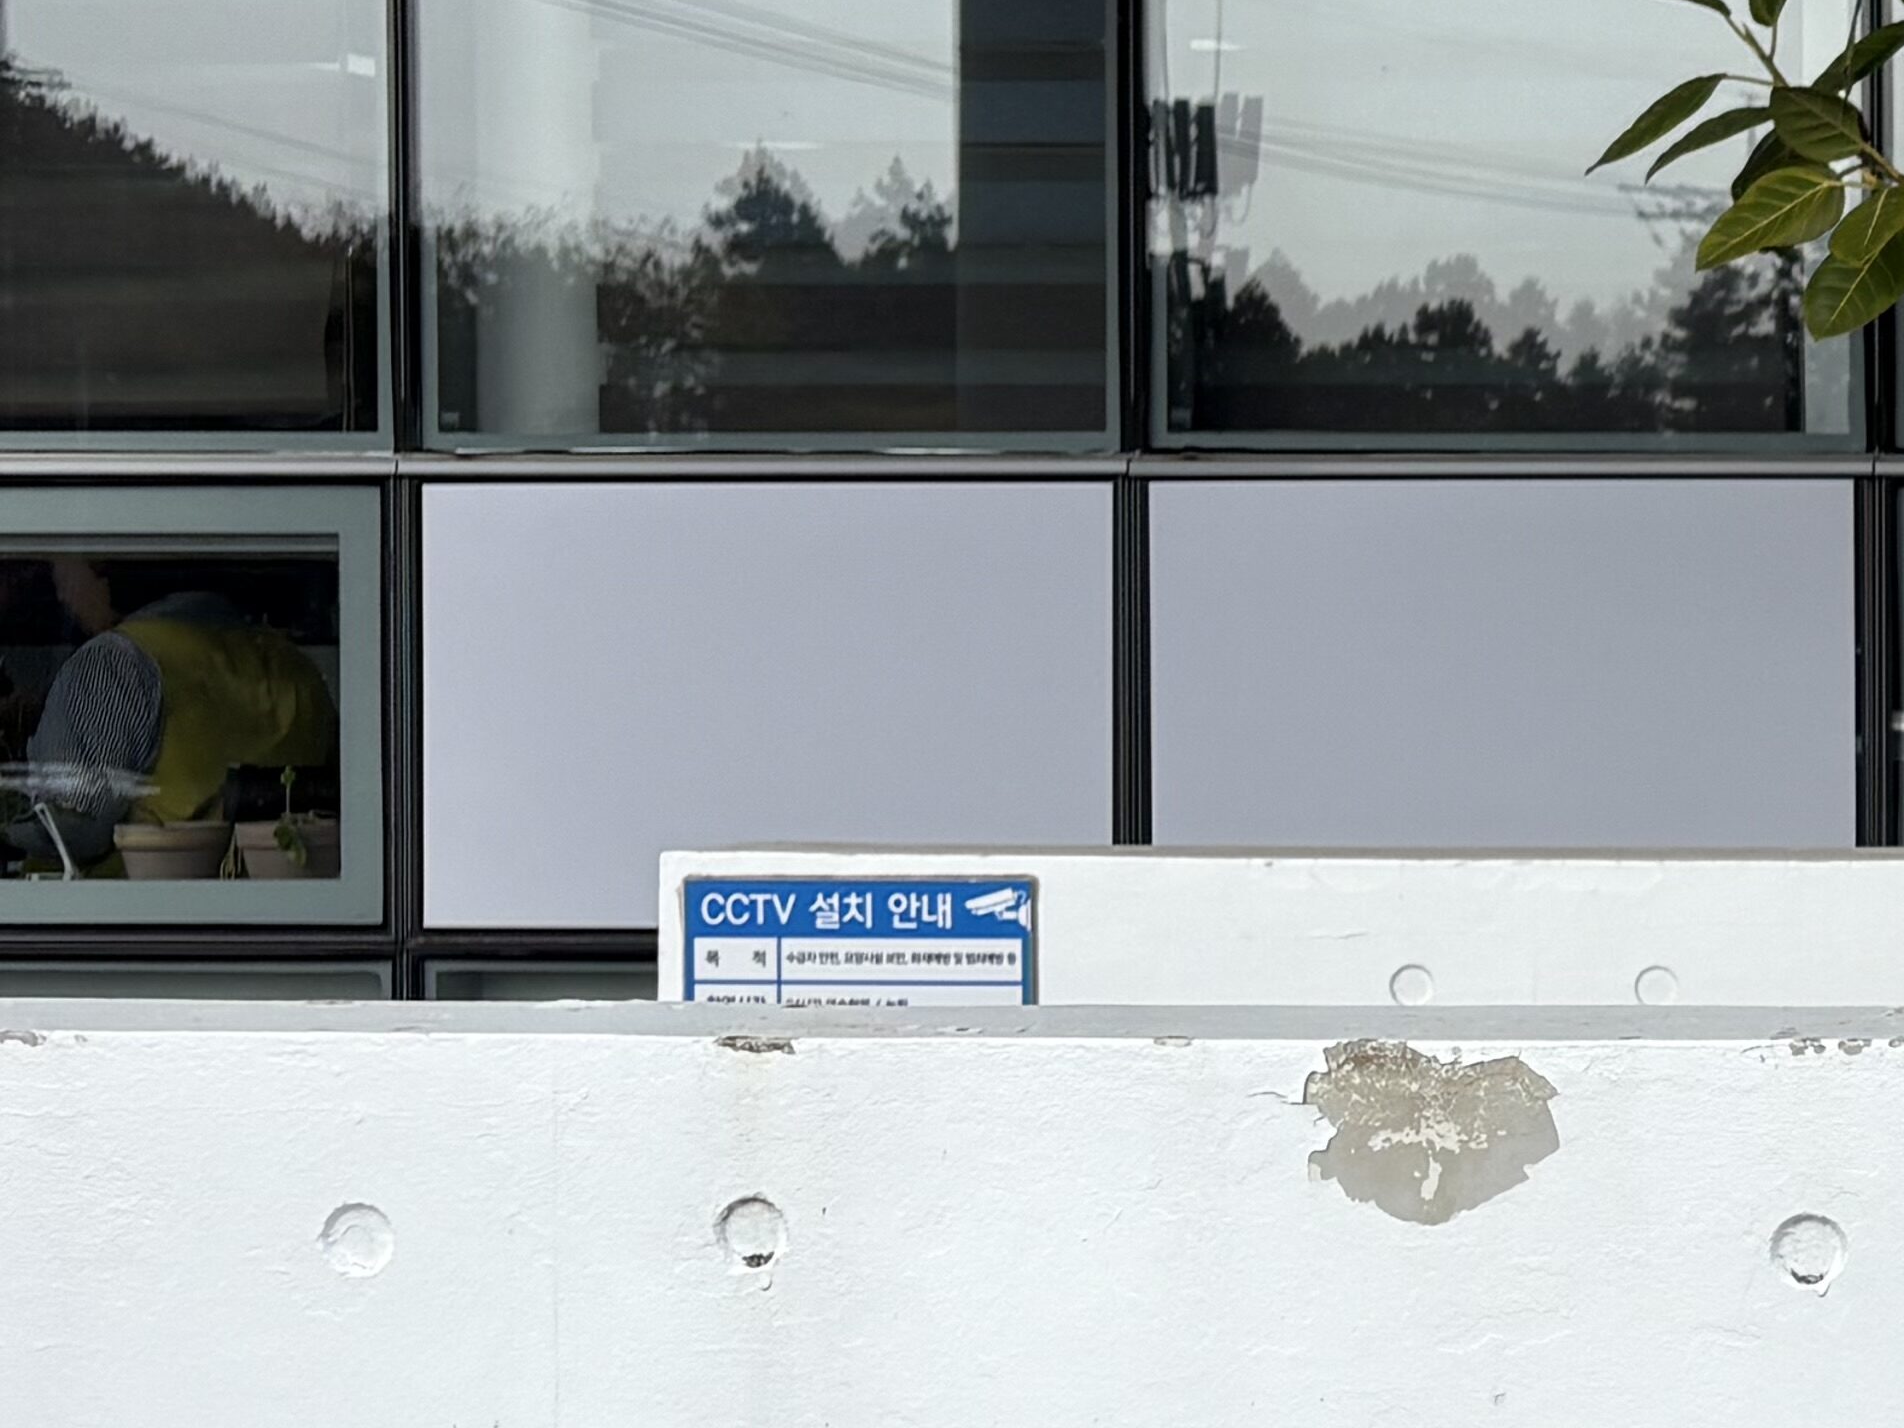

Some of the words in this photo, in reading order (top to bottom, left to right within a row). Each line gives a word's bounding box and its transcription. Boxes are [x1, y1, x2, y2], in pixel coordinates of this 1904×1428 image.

[701, 892, 796, 926] CCTV
[808, 891, 873, 930] 설치
[887, 891, 954, 930] 안내
